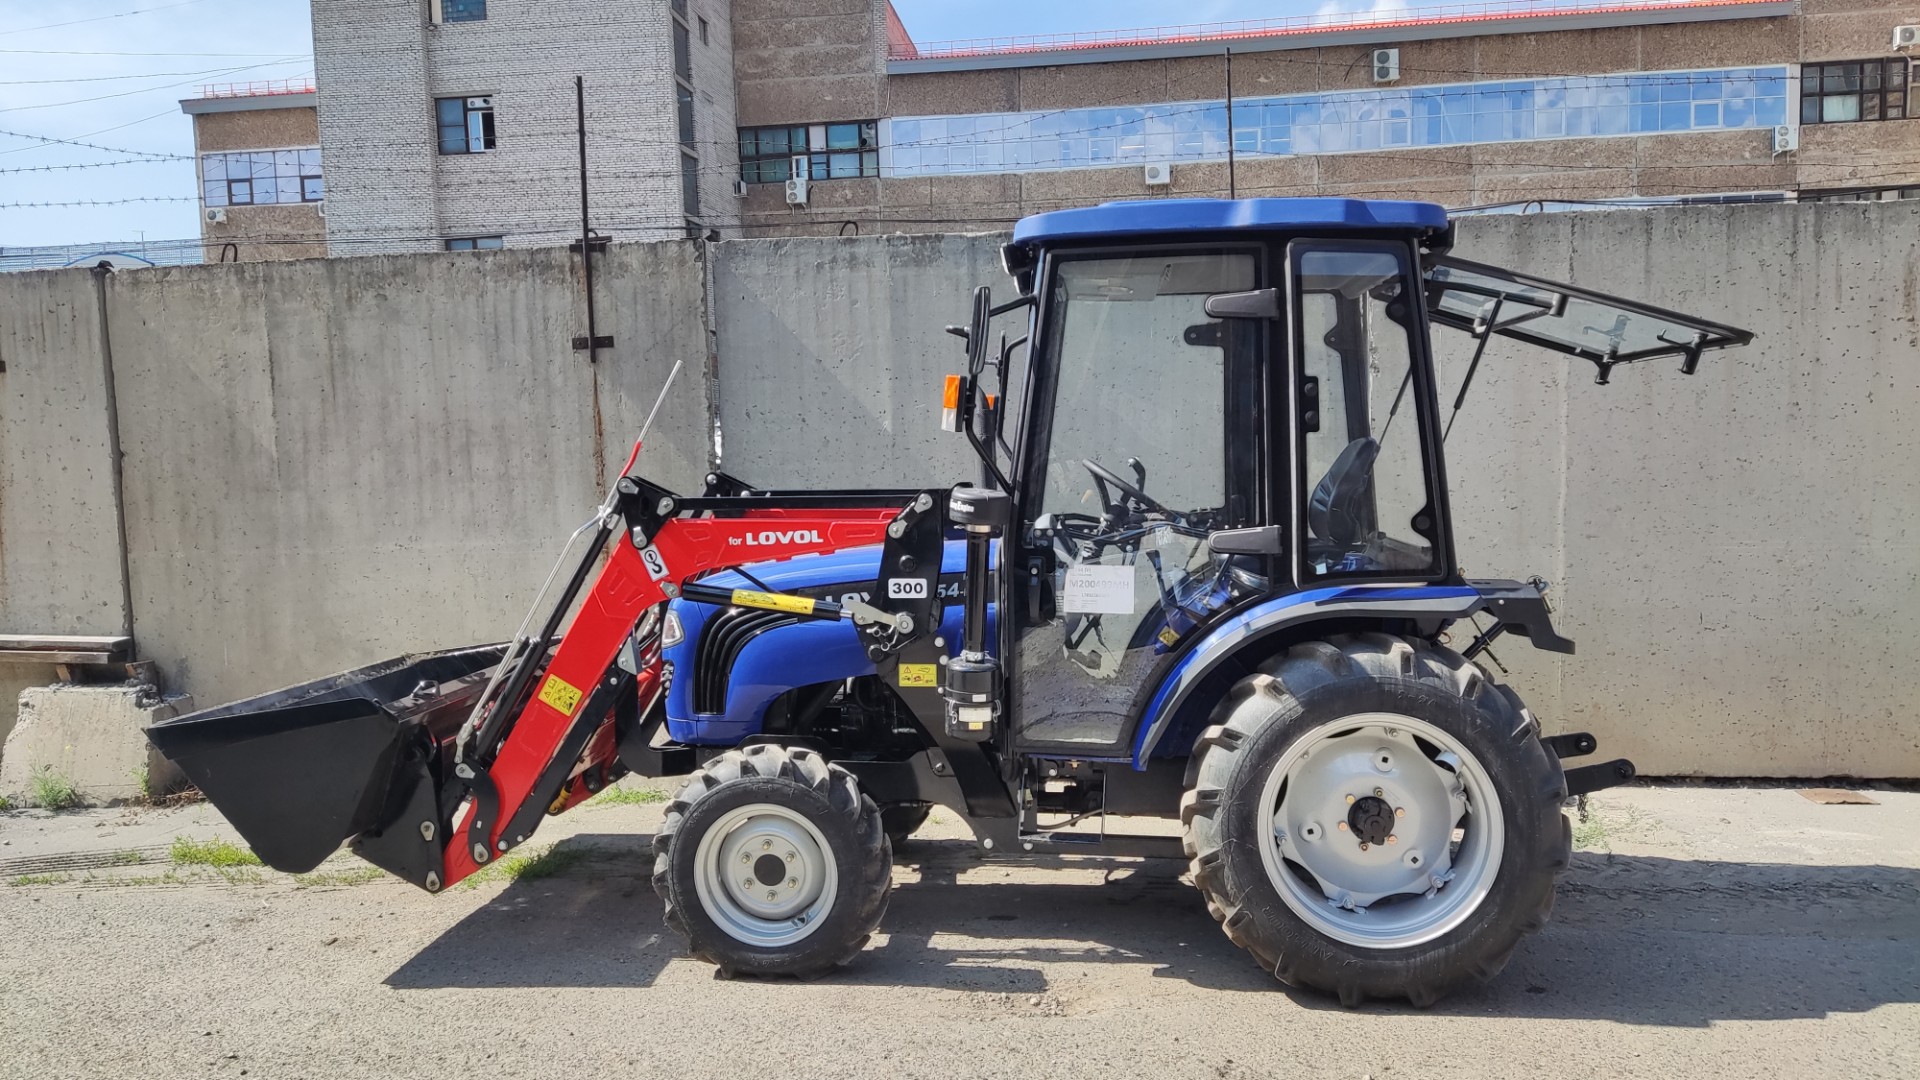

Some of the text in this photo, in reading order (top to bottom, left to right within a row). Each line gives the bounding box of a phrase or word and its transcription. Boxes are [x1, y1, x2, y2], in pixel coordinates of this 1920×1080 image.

[728, 530, 824, 546] for LOVOL
[892, 582, 924, 595] 300
